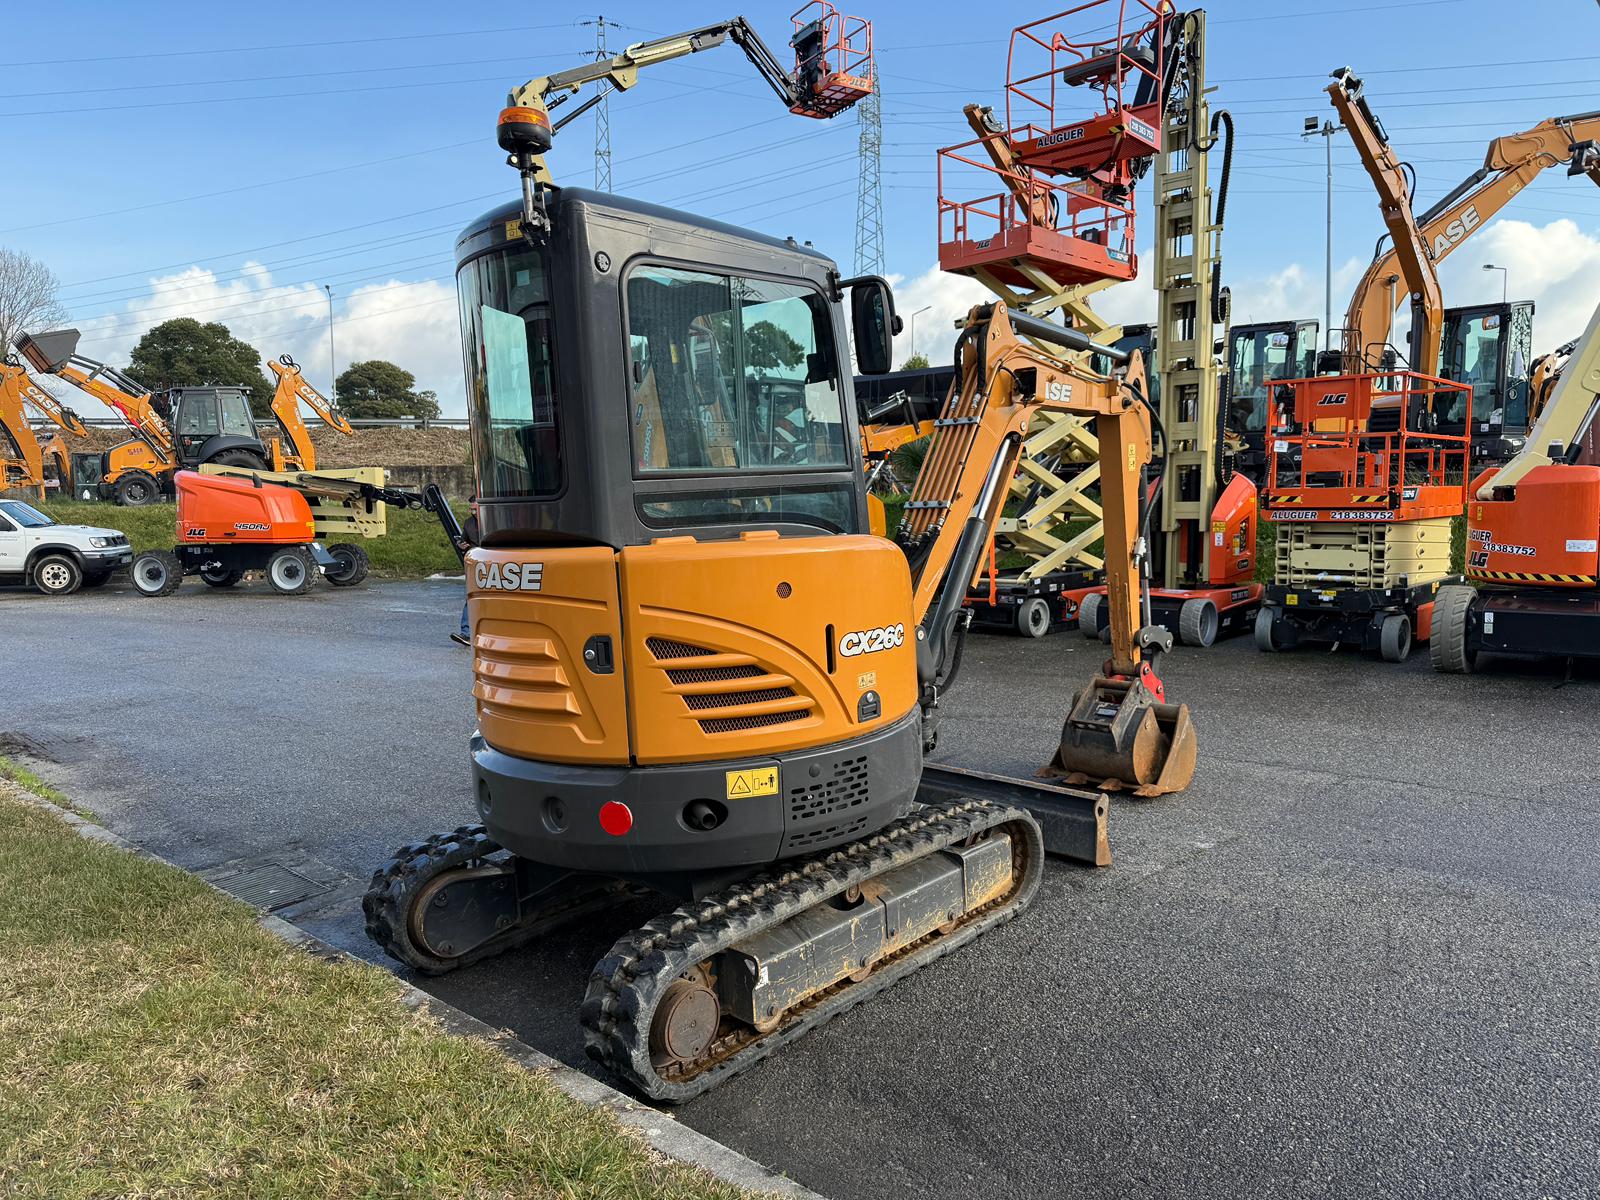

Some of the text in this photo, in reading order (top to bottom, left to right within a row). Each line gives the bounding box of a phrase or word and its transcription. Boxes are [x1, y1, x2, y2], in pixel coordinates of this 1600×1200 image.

[1036, 127, 1085, 148] ALUGUER
[1433, 203, 1481, 260] ASE
[975, 240, 991, 249] JLG
[26, 386, 62, 416] CASE
[300, 385, 331, 414] CASE
[1317, 393, 1348, 406] JLG
[147, 410, 170, 436] CASE
[1270, 510, 1395, 520] ALUGUER 218383752
[186, 528, 206, 537] JLG
[233, 522, 272, 532] 450AJ
[1470, 530, 1492, 542] GUER
[1481, 541, 1537, 557] 218383752
[475, 561, 545, 592] CASE
[838, 622, 905, 657] CX26C
